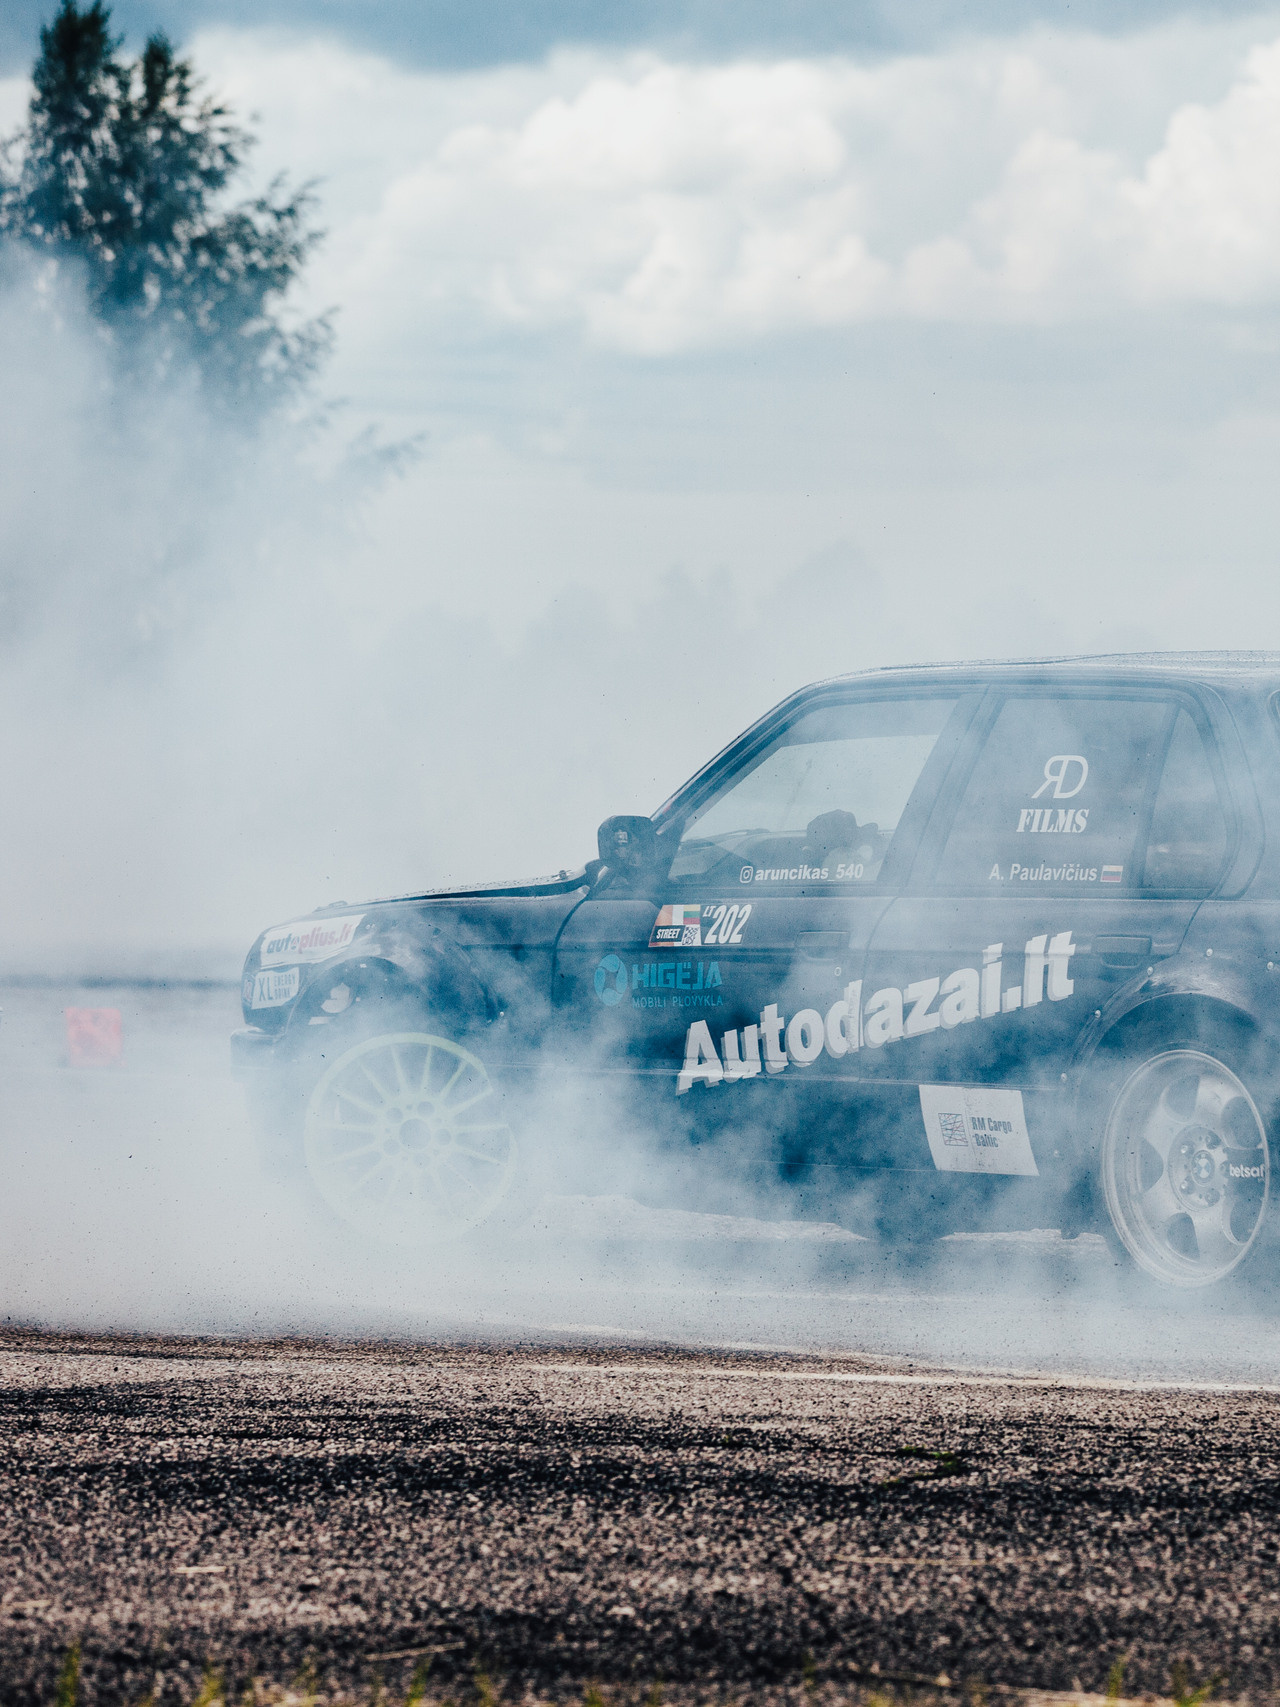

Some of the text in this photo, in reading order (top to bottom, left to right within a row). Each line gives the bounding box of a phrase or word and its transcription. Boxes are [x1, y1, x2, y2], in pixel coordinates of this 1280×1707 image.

[1016, 808, 1089, 833] FILMS
[988, 863, 1098, 881] A. Paulavičius
[656, 928, 681, 940] STREET
[702, 904, 752, 944] LT 202
[266, 923, 354, 955] autoplius.lt
[258, 976, 274, 1002] XL
[632, 995, 723, 1009] MOBILI PLOVYKLA
[675, 930, 1077, 1096] Autodazai.lt
[971, 1116, 1013, 1135] RM Cargo
[975, 1133, 999, 1148] Baltic
